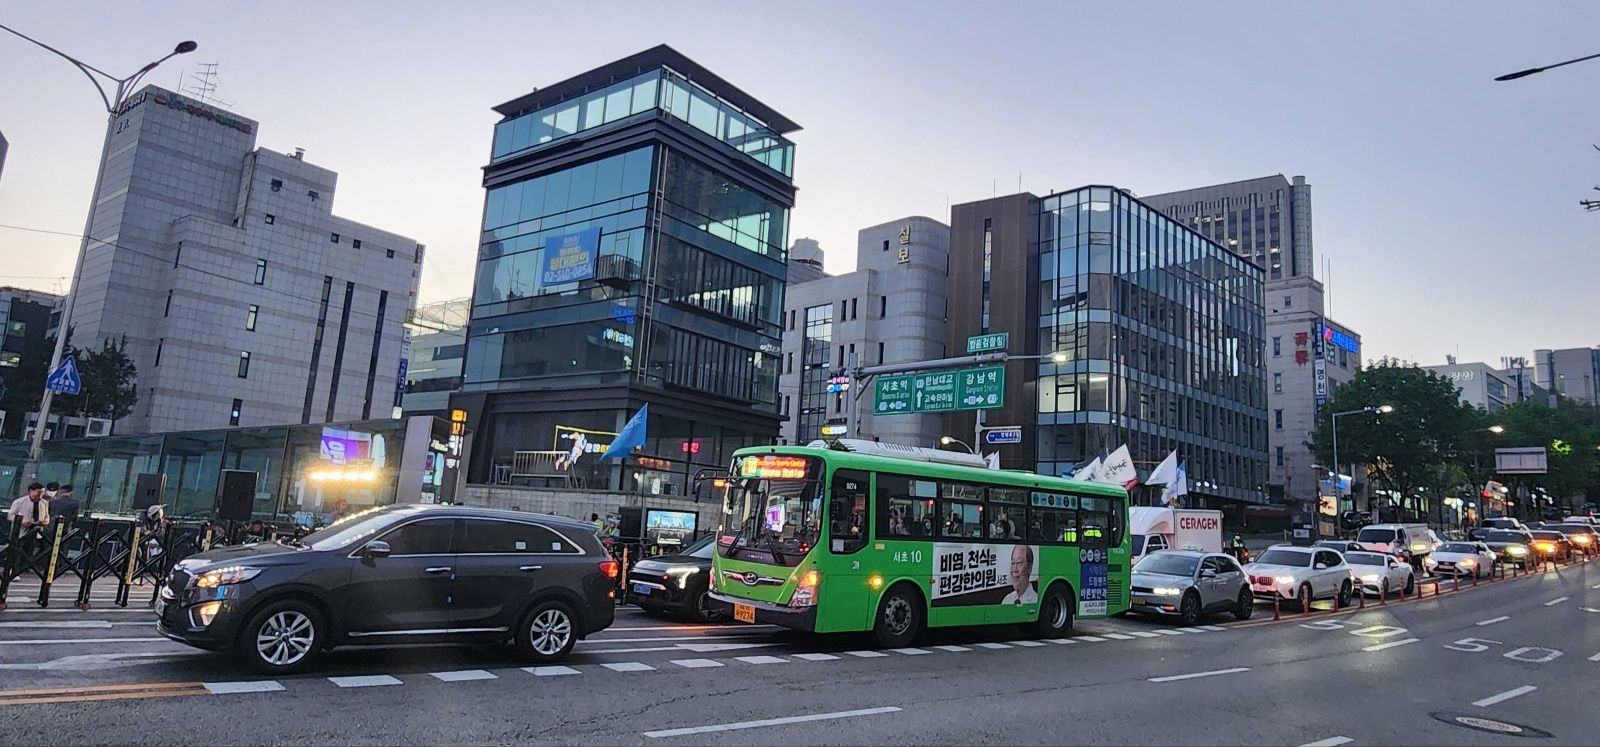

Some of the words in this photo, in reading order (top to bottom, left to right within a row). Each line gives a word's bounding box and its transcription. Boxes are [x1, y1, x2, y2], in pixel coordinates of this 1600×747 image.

[926, 374, 953, 386] 한남대교
[966, 370, 996, 385] 강남역
[882, 379, 908, 392] 서초역
[1180, 517, 1218, 530] CERAGEM
[892, 551, 908, 564] 서초
[911, 550, 922, 563] 10
[940, 552, 966, 573] 비염,
[968, 548, 997, 569] 천식은
[940, 568, 997, 596] 편강한의원
